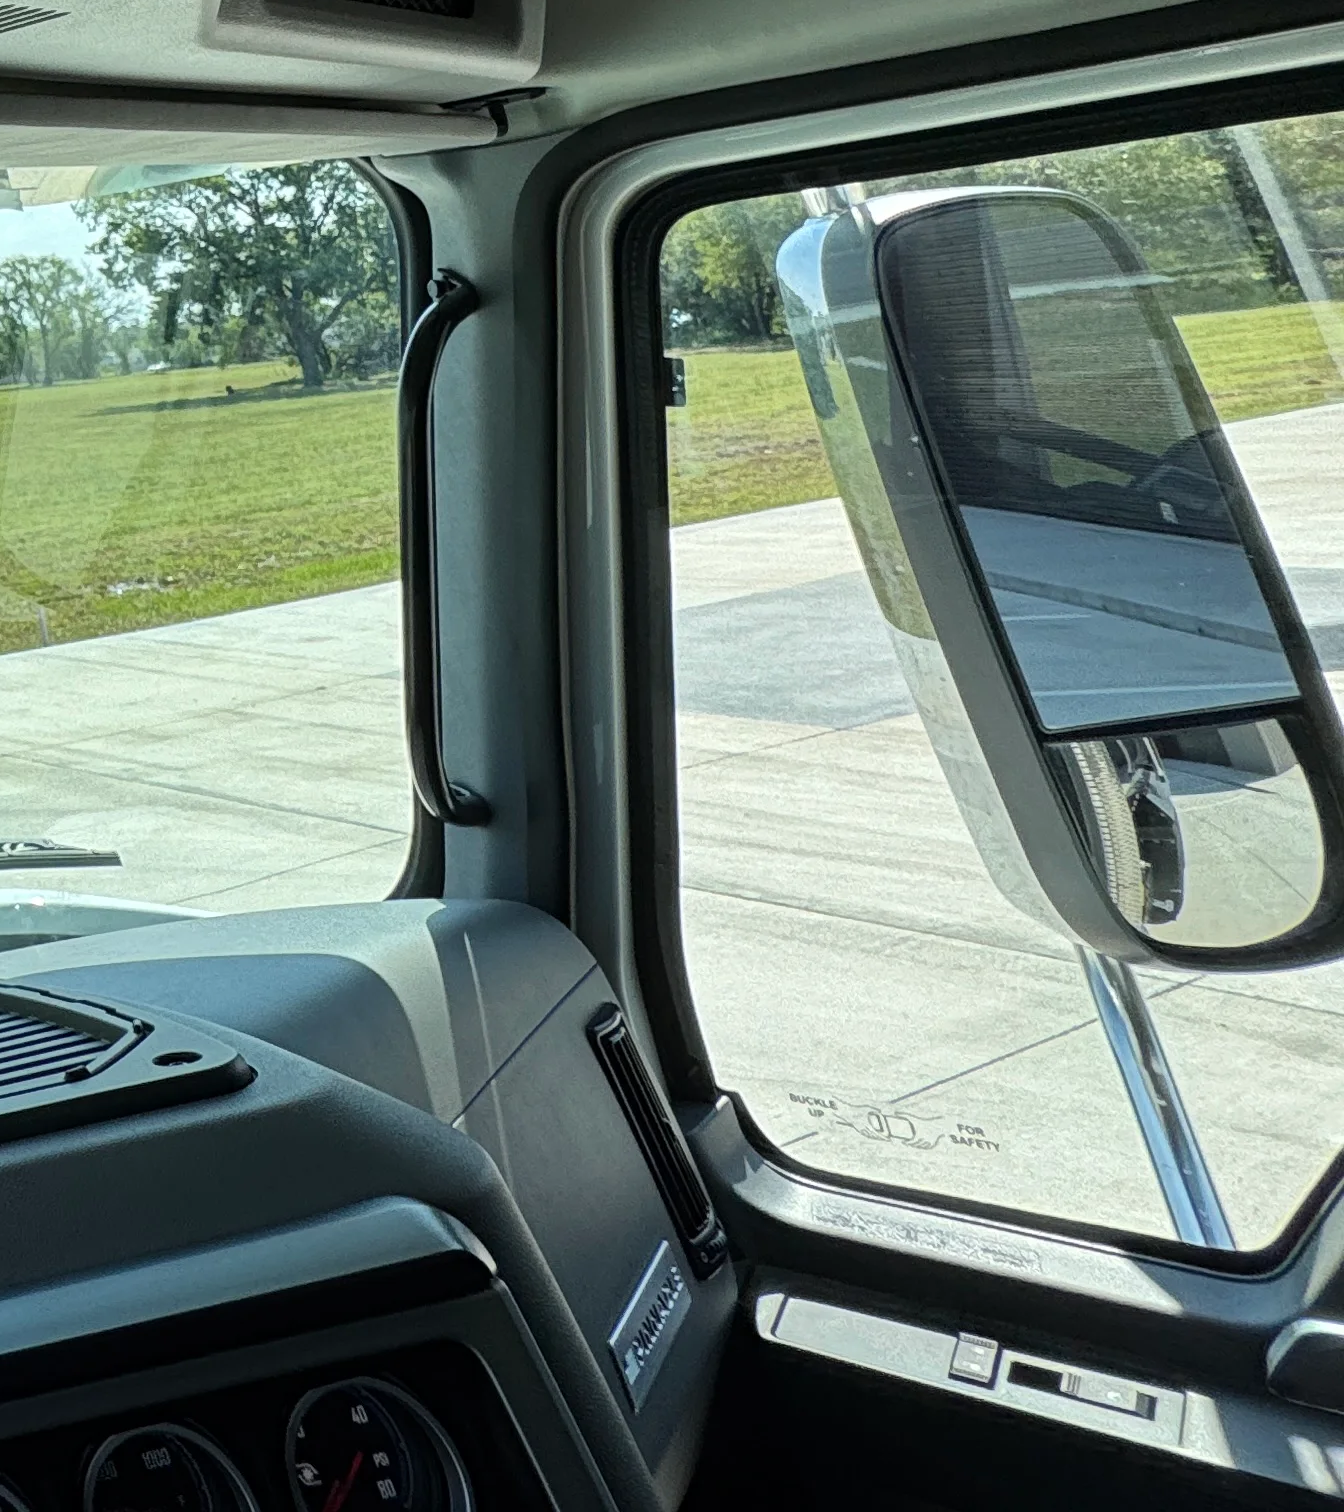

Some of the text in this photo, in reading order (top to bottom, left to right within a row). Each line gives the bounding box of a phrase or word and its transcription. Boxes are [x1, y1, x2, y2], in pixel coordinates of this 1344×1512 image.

[789, 1092, 839, 1111] BUCKLE
[808, 1107, 825, 1118] UP
[956, 1123, 986, 1137] FOR
[949, 1134, 1000, 1153] SAFETY
[350, 1403, 369, 1425] 40
[371, 1450, 390, 1468] PSI
